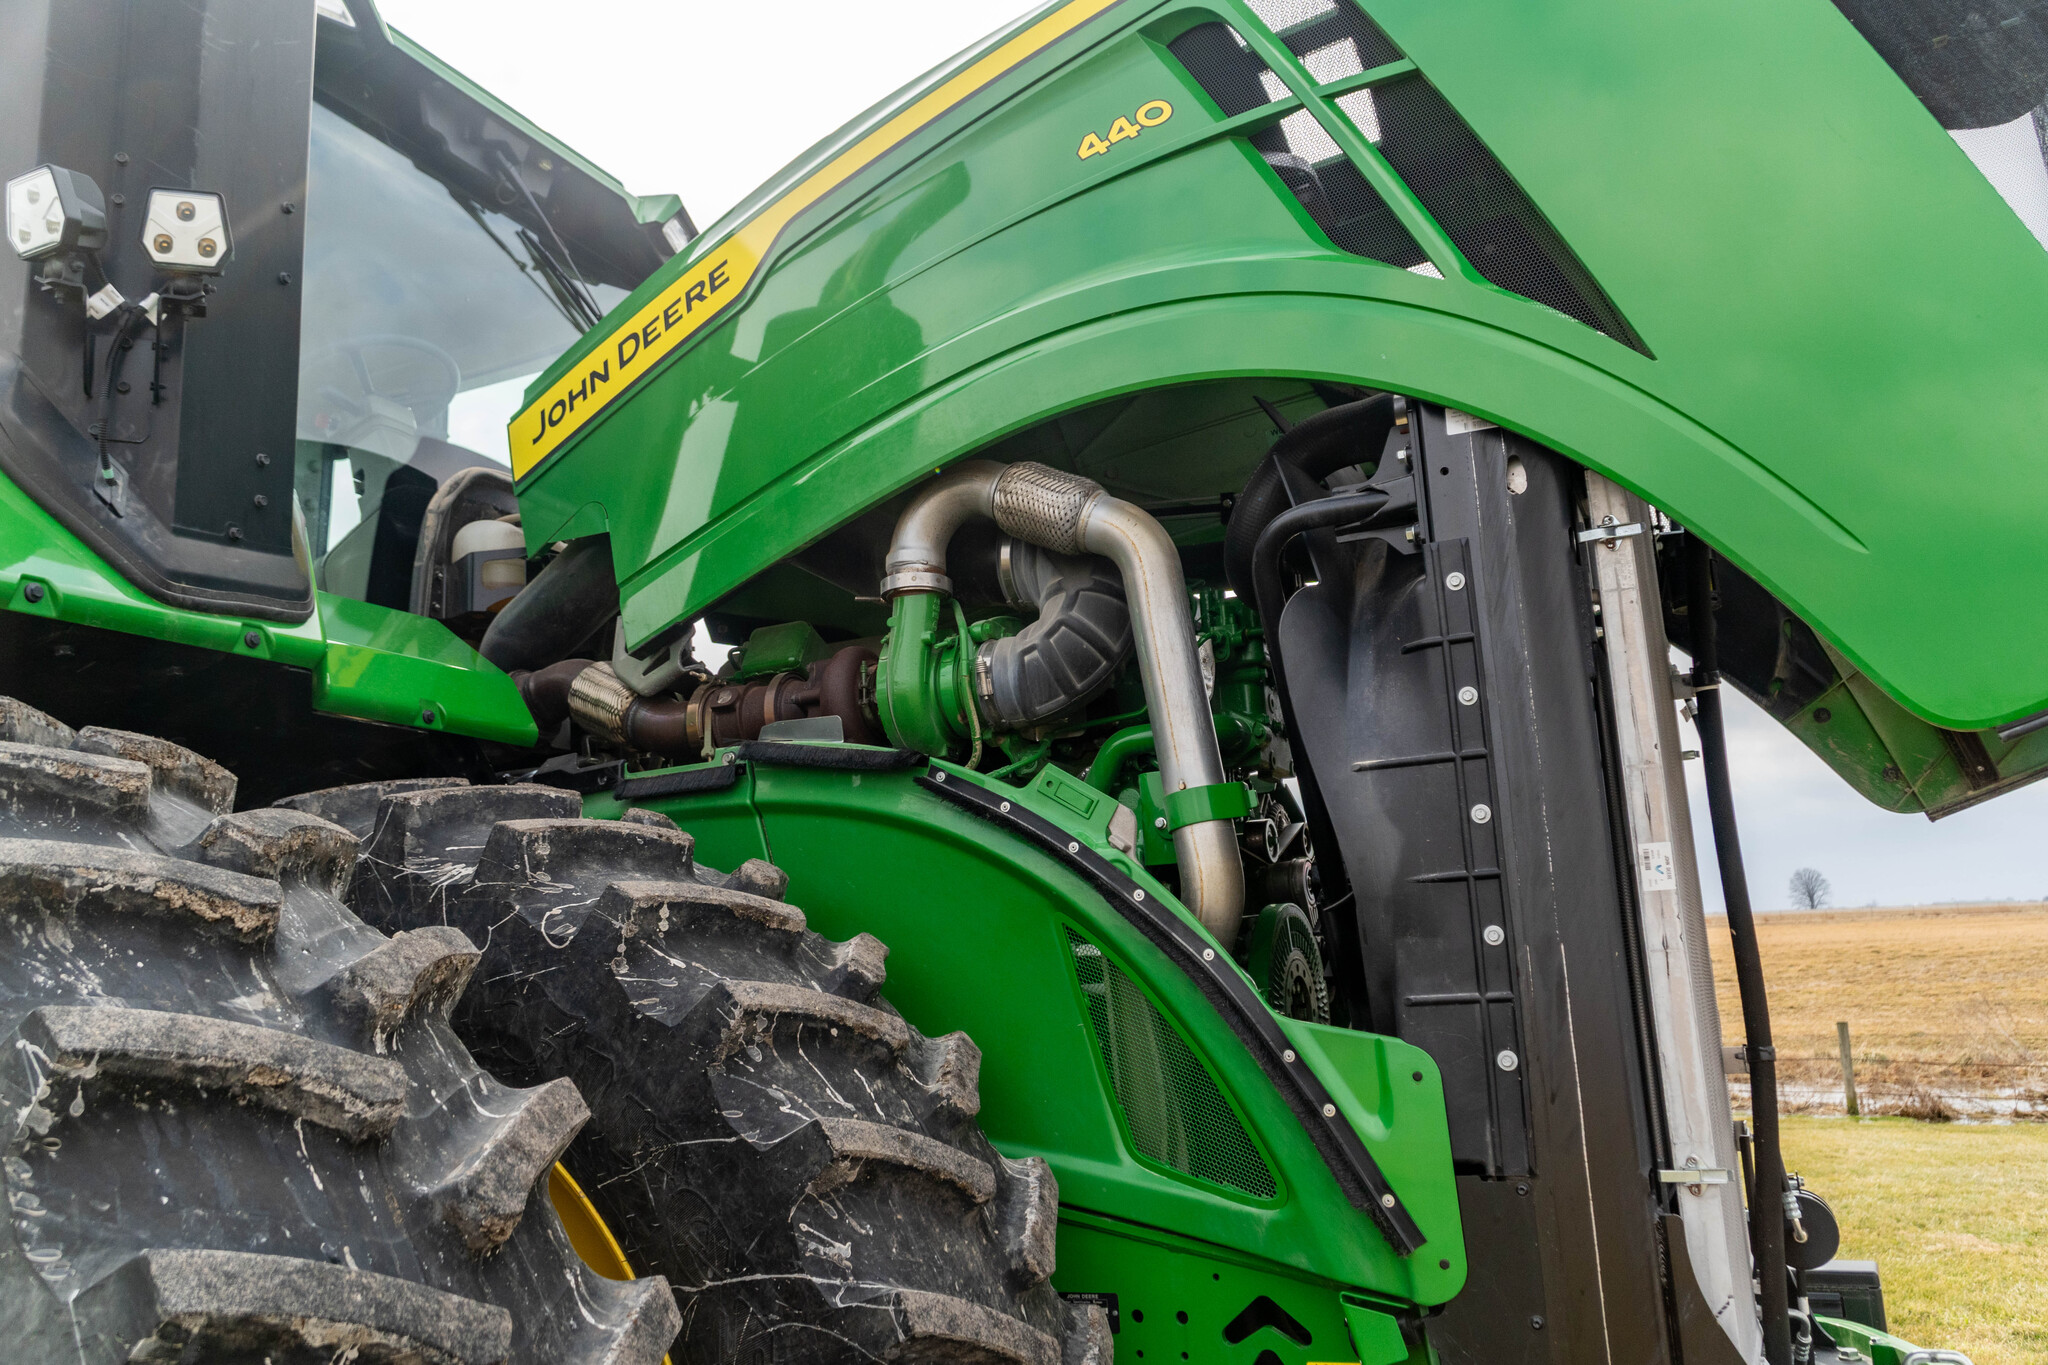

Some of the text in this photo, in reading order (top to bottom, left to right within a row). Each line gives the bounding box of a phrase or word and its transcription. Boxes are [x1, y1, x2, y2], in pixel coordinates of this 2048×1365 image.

[1077, 99, 1174, 161] 440
[532, 259, 730, 446] JOHN DEERE
